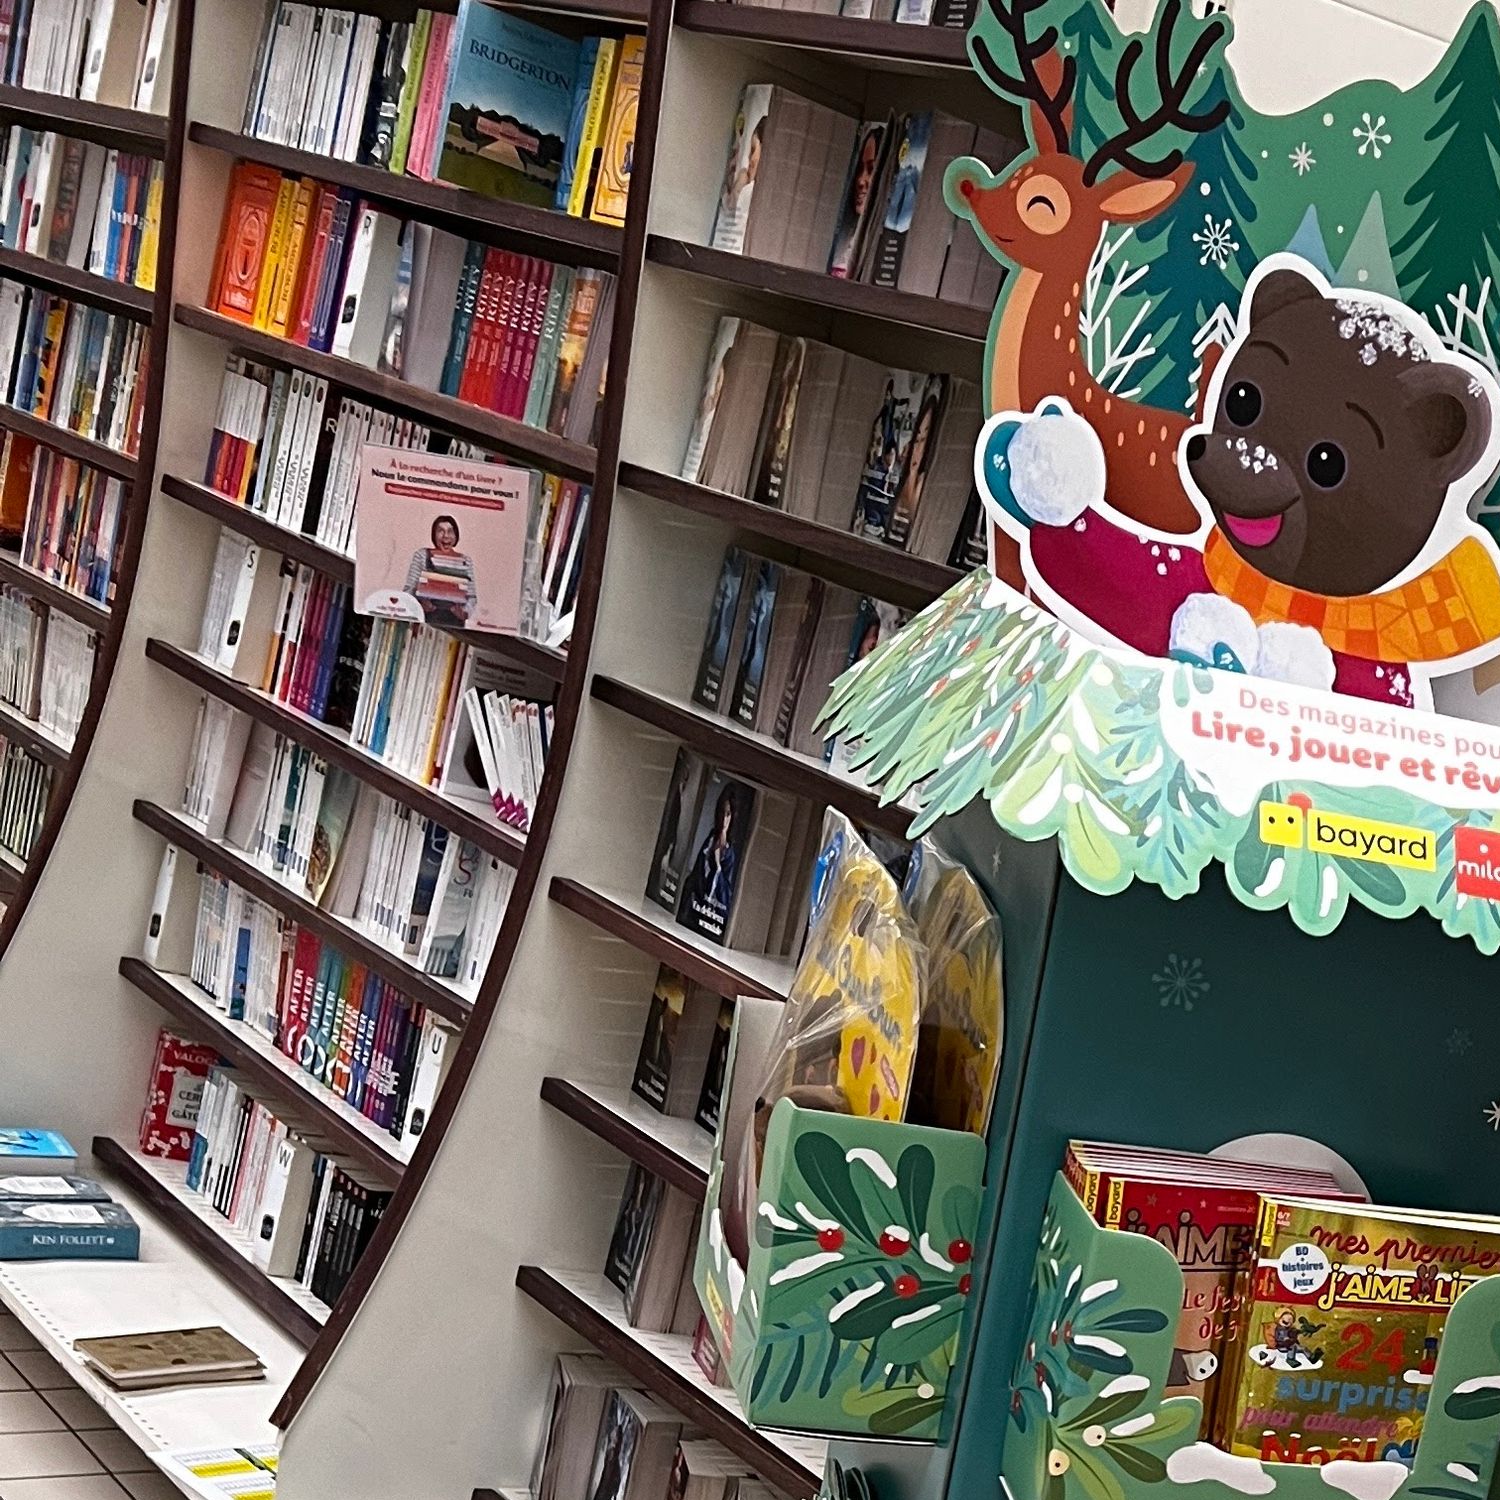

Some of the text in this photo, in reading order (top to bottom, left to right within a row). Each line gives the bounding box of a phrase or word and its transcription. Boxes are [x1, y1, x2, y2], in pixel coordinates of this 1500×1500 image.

[469, 39, 571, 91] BRIDGERTON
[371, 468, 396, 481] Nous
[396, 472, 407, 482] le
[407, 474, 469, 492] commandons
[470, 484, 492, 497] pour
[493, 488, 514, 499] vous
[408, 465, 454, 479] recherche
[455, 471, 476, 482] d'un
[476, 474, 497, 484] livre
[1239, 688, 1291, 717] Des
[1299, 706, 1446, 749] magazines
[1191, 710, 1279, 757] Lire,
[1288, 727, 1391, 772] jouer
[1399, 756, 1437, 782] et
[1316, 817, 1428, 861] bayard
[1110, 1182, 1122, 1221] bayard
[32, 1234, 107, 1246] KEN FOLLETT
[1310, 1225, 1370, 1255] mes
[1282, 1261, 1325, 1273] histoires
[1292, 1276, 1314, 1289] jeux
[1335, 1322, 1407, 1374] 24
